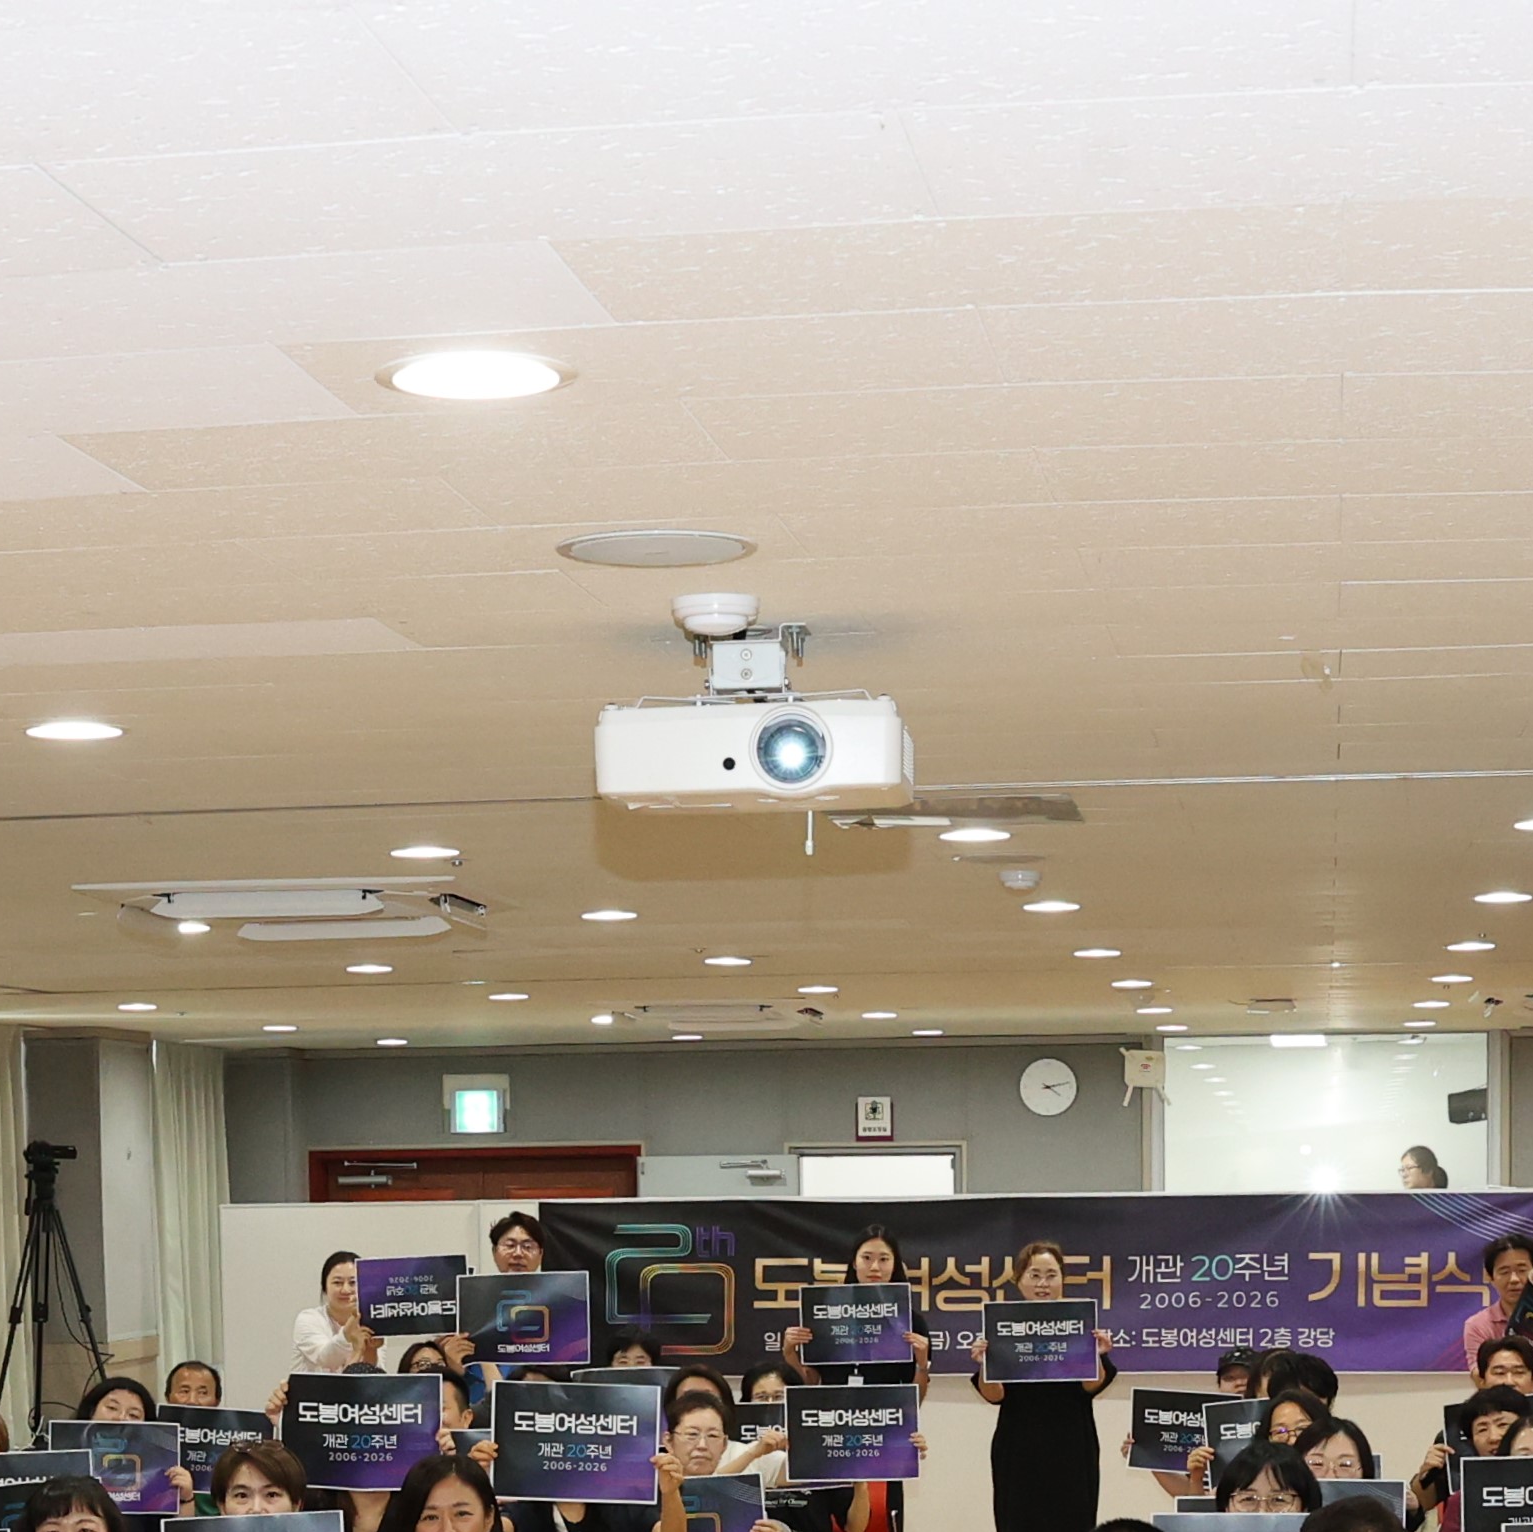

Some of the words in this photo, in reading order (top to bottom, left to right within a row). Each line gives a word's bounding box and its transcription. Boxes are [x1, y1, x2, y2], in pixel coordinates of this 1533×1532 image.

[1127, 1255, 1184, 1283] 개관
[1190, 1252, 1290, 1283] 20주년
[1139, 1291, 1280, 1309] 2006-2026
[370, 1300, 457, 1319] 도봉여성센터
[813, 1303, 899, 1319] 도봉여성센터
[996, 1320, 1084, 1336] 도봉여성센터
[1141, 1328, 1254, 1348] 도봉여성센터
[1259, 1328, 1292, 1348] 2층
[1297, 1327, 1336, 1348] 강당
[298, 1402, 422, 1426] 도봉여성센터
[801, 1408, 903, 1427] 도봉여성센터
[1144, 1408, 1205, 1428] 도봉여성
[513, 1411, 638, 1437] 도봉여성센터
[322, 1433, 349, 1449] 개관
[351, 1433, 398, 1450] 20주년
[822, 1434, 844, 1447] 개관
[328, 1451, 394, 1463] 2006-2026
[537, 1442, 565, 1458] 개관
[567, 1443, 613, 1460] 20주년
[826, 1449, 880, 1458] 2006-2026
[542, 1460, 608, 1473] 2006-2026
